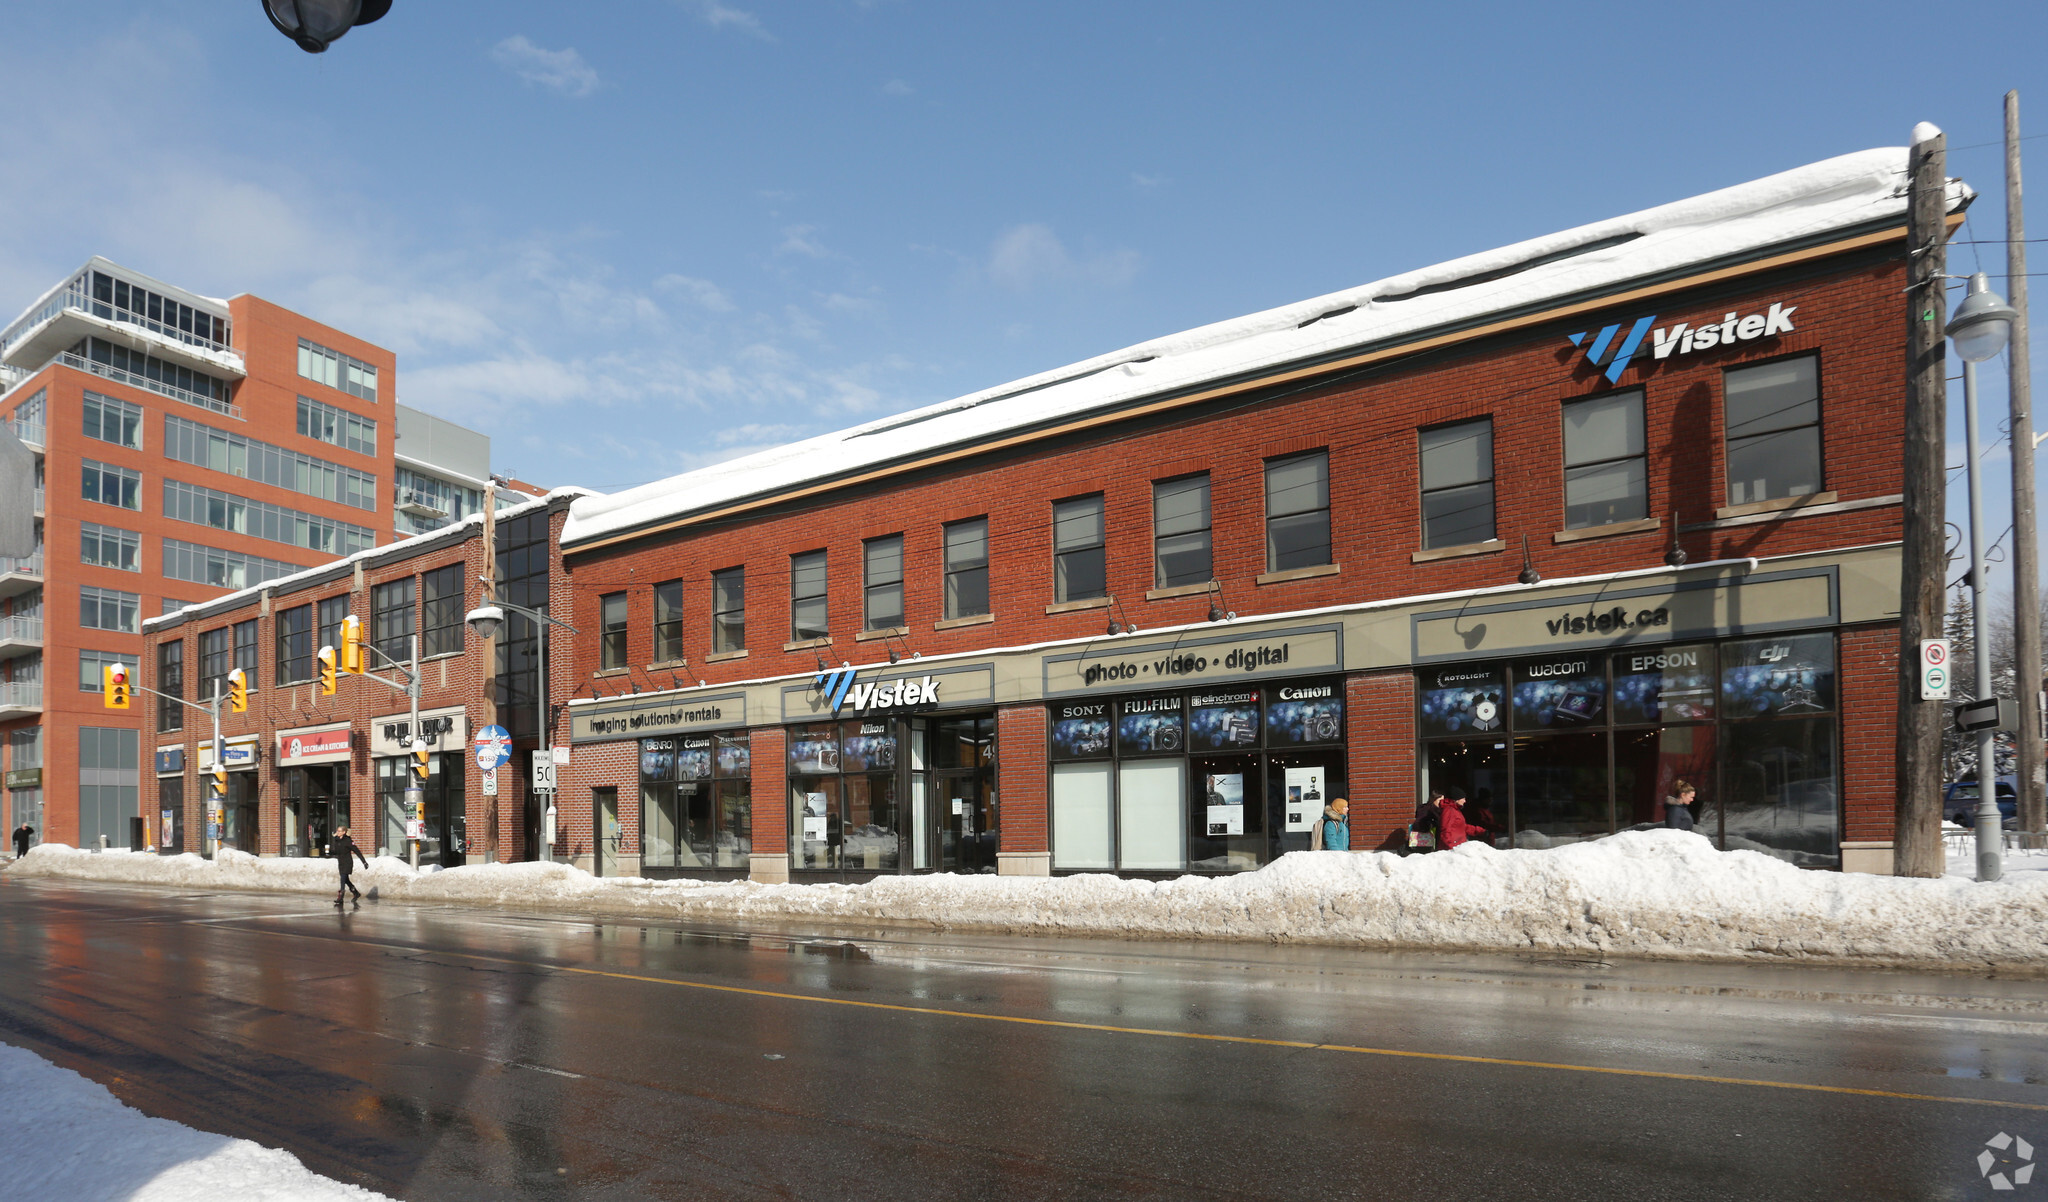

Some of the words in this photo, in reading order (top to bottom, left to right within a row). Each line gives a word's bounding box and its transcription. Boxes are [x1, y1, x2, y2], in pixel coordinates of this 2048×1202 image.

[1653, 302, 1797, 359] Vistek
[1546, 605, 1669, 637] vistek.ca
[1085, 662, 1138, 686] photo
[1153, 655, 1207, 675] video
[1224, 643, 1289, 672] digital
[1529, 662, 1586, 677] wacom
[1631, 652, 1697, 672] EPSON
[1444, 672, 1490, 682] ROTOLIGHT
[854, 675, 940, 710] Vistek
[1201, 692, 1250, 703] elinchrom
[1279, 686, 1332, 701] Canon
[1063, 704, 1105, 718] SONY
[1125, 697, 1181, 714] FUJIFILM
[590, 716, 627, 734] imaging
[629, 711, 676, 729] solutions
[684, 706, 721, 722] rentals
[860, 724, 885, 735] Nikon
[646, 740, 673, 751] BENRO
[684, 739, 710, 749] Canon
[537, 766, 550, 781] 50
